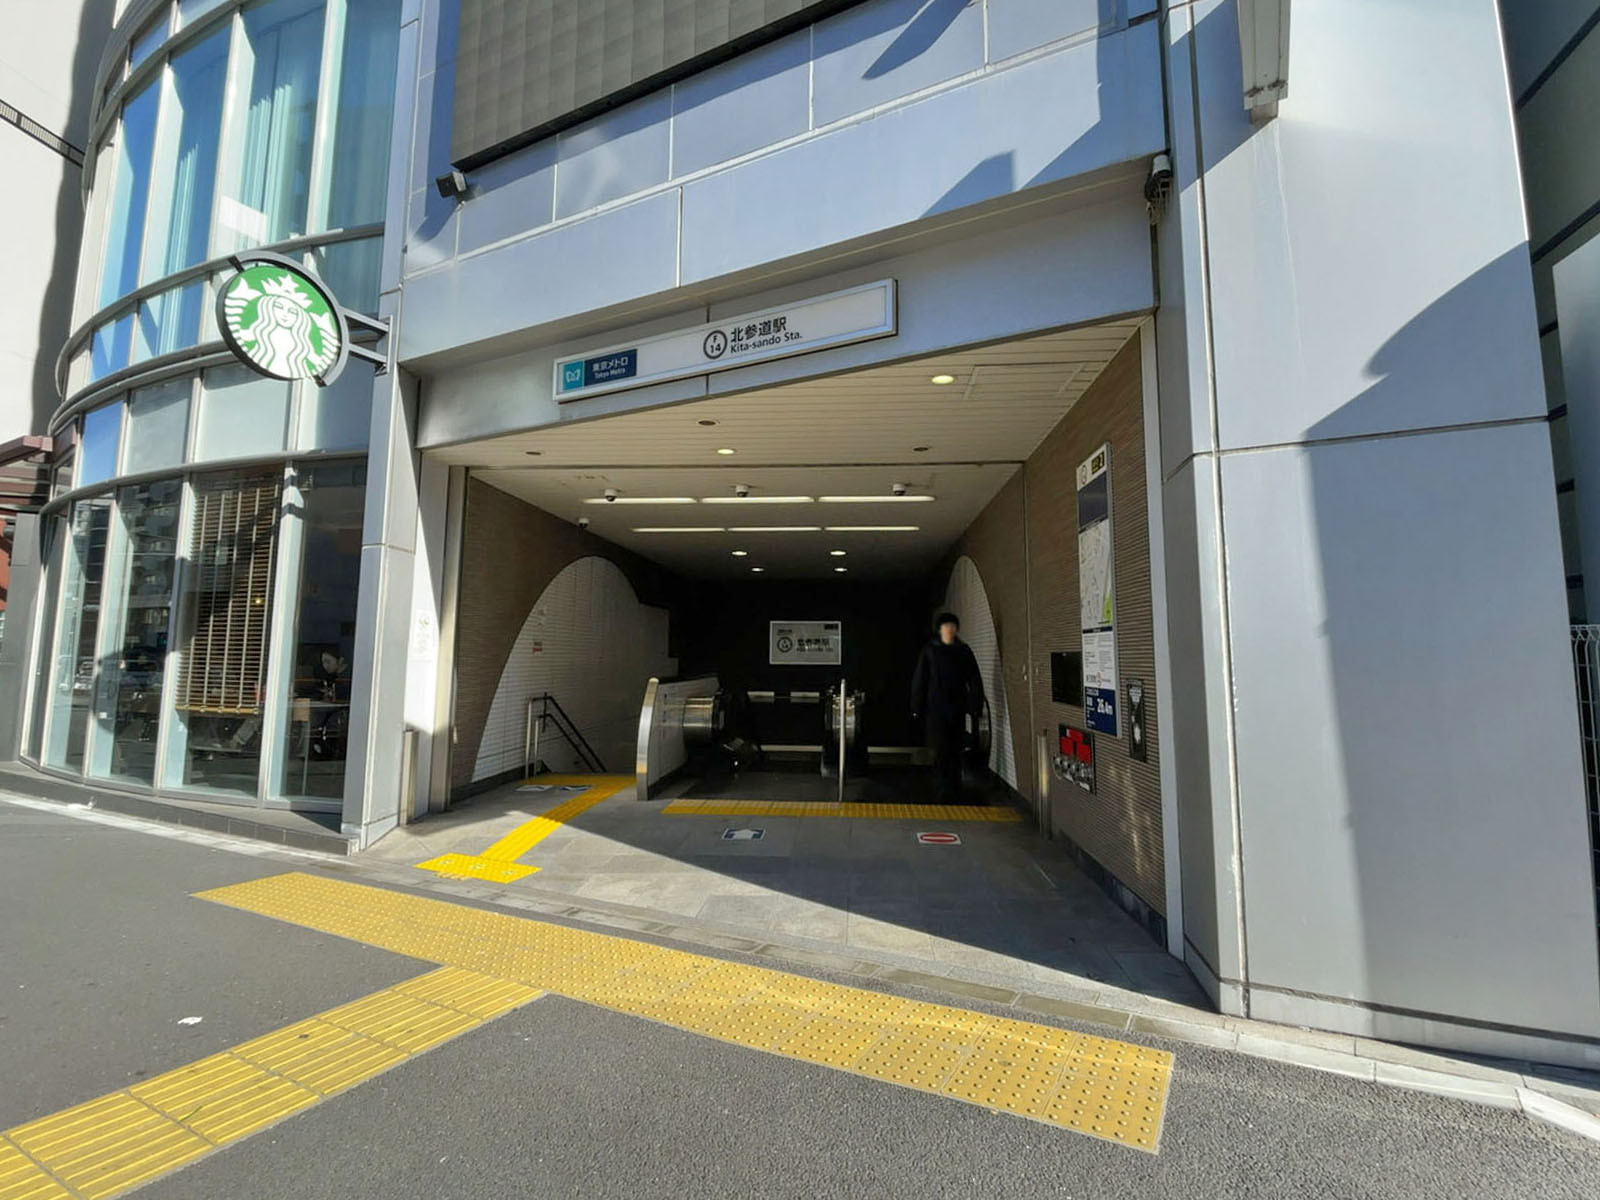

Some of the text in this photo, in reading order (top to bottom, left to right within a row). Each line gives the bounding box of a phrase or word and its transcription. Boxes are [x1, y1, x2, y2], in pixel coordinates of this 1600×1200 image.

[731, 317, 787, 343] 北参道駅
[711, 343, 721, 354] 14
[731, 331, 803, 354] Kita-sando Sta.
